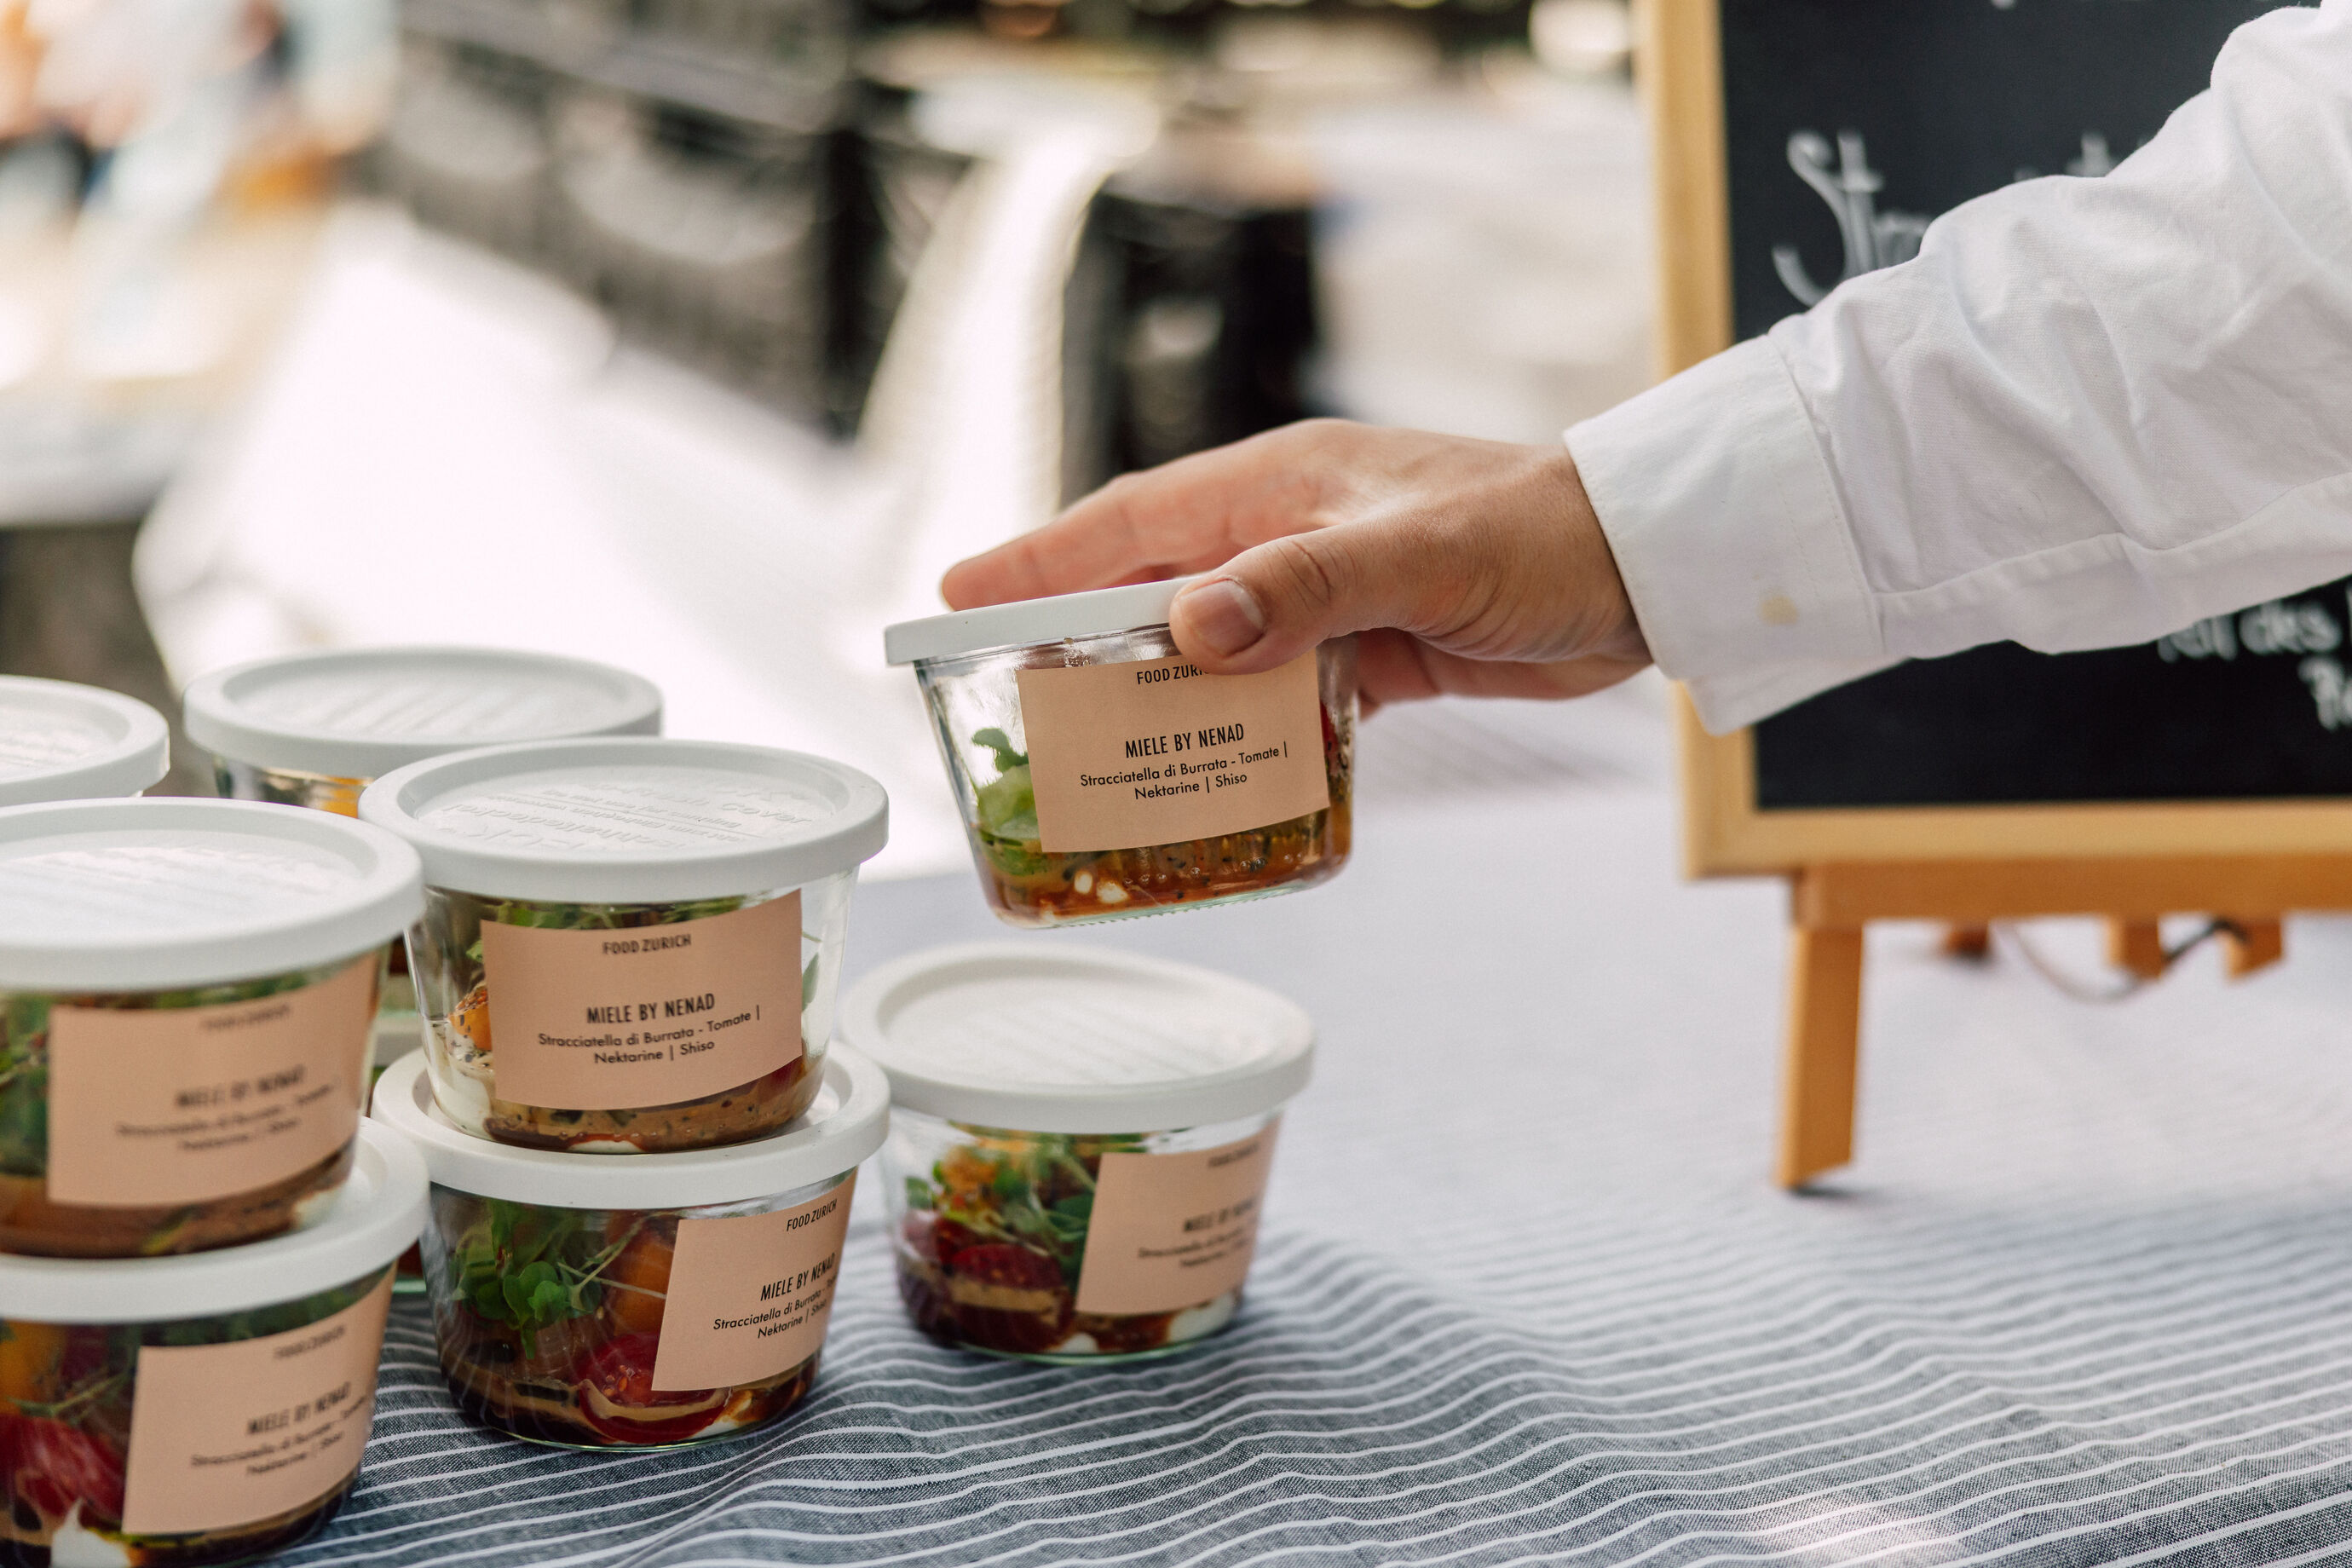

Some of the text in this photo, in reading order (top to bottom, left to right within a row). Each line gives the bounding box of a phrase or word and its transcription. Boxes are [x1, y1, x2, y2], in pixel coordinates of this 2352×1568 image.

[1137, 668, 1171, 684] FOOD
[1125, 723, 1245, 758] MIELE BY NENAD
[1081, 767, 1160, 787] Stracciatella
[1164, 764, 1176, 777] di
[1180, 759, 1227, 775] Burrata
[1238, 747, 1279, 765] Tomate
[1134, 782, 1200, 799] Nektarine
[1215, 774, 1248, 787] Shiso
[602, 933, 692, 955] FOOD ZURICH
[586, 993, 715, 1024] MIELE BY NENAD
[538, 1033, 622, 1048] Stracciatella
[625, 1032, 639, 1045] di
[643, 1027, 695, 1044] Burrata
[706, 1012, 752, 1033] Tomate
[594, 1050, 663, 1064] Nektarine
[679, 1040, 715, 1056] Shiso
[786, 1198, 838, 1231] FOOD ZURICH
[760, 1277, 793, 1301] MIELE
[796, 1270, 809, 1289] BY
[811, 1252, 836, 1282] NENAD
[712, 1308, 781, 1330] Stracciatella
[783, 1302, 793, 1316] di
[794, 1289, 821, 1311] Burrata
[758, 1316, 803, 1339] Nektarine
